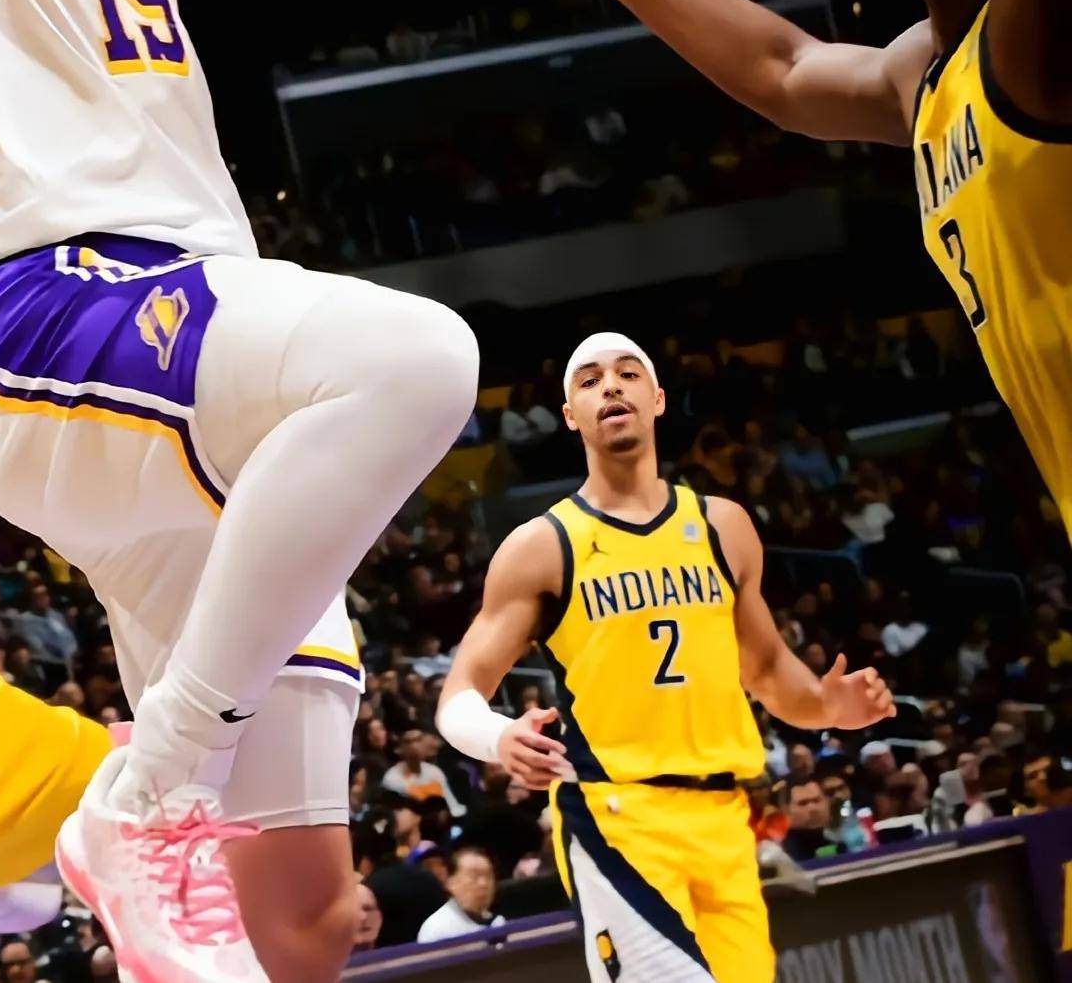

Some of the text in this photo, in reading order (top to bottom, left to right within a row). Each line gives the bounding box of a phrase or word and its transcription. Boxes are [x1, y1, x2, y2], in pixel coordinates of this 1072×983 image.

[939, 218, 987, 329] 3
[580, 565, 724, 621] INDIANA
[649, 620, 685, 685] 2
